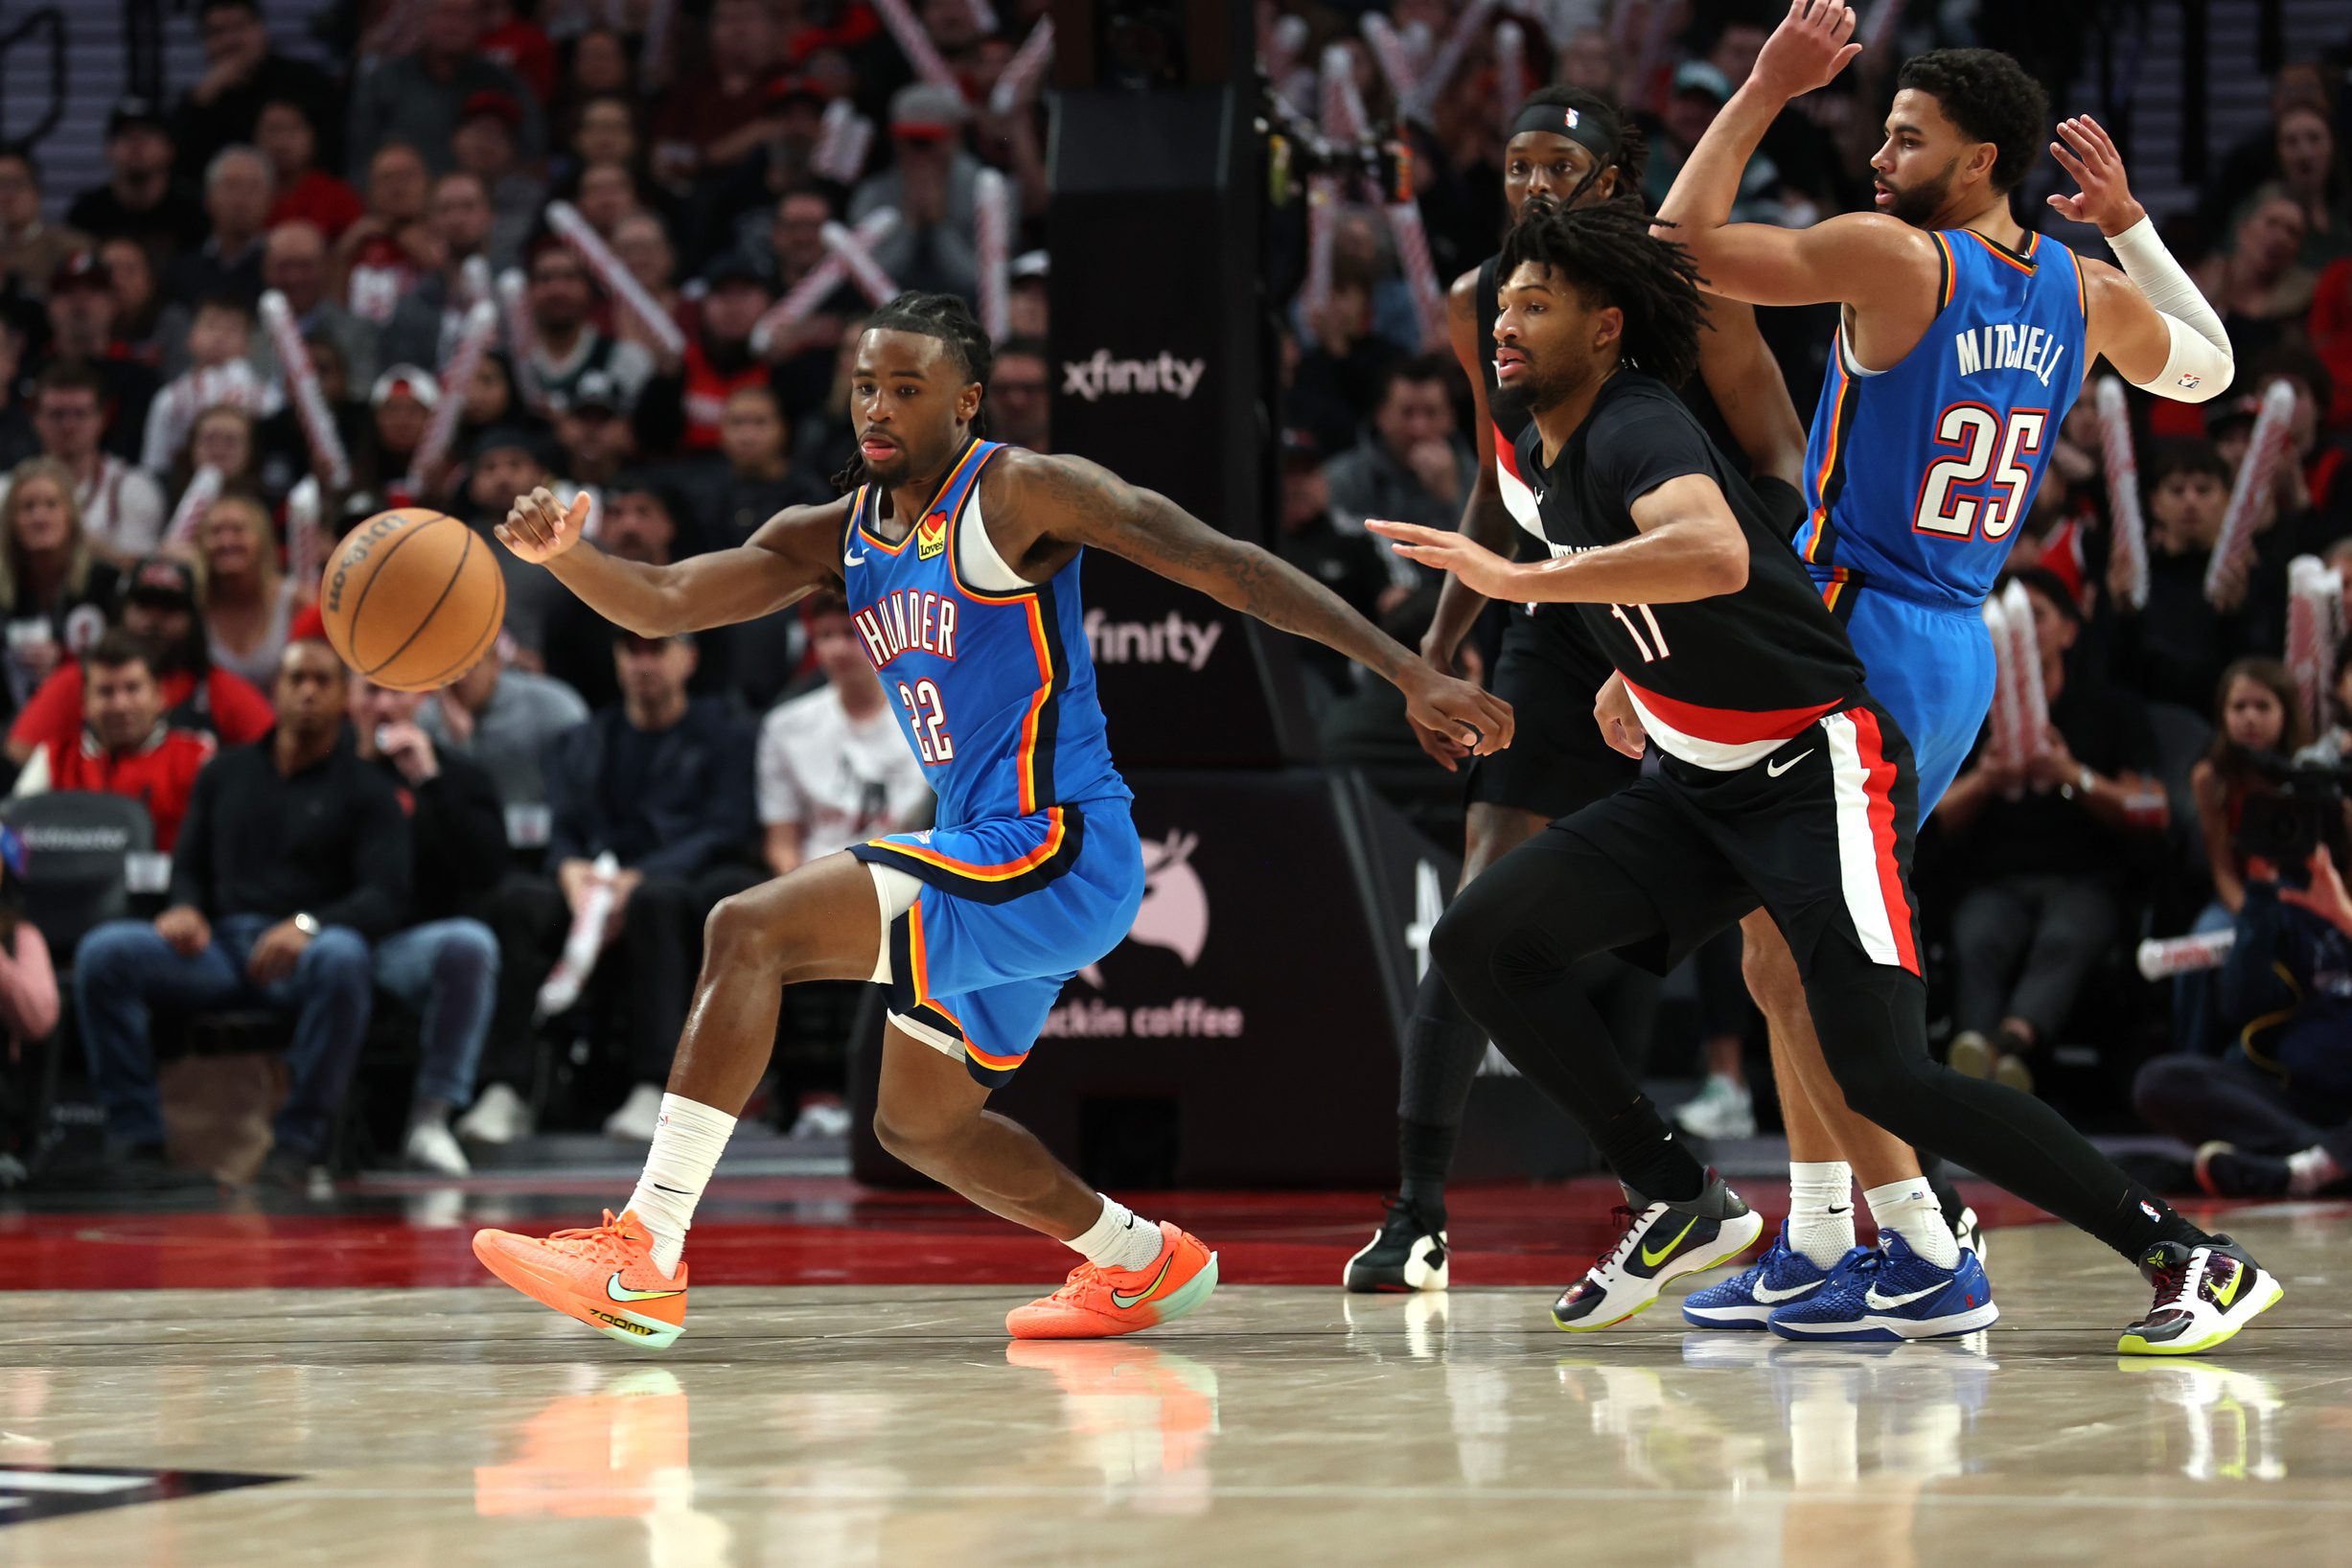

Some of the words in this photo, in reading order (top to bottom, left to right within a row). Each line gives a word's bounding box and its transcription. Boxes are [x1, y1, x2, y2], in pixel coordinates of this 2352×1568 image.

[1061, 348, 1206, 402] xfinity
[1956, 324, 2064, 387] MITCHELL
[1912, 401, 2049, 543] 25
[851, 588, 957, 671] HUNDER
[1083, 608, 1223, 671] finity
[898, 677, 954, 765] 22
[1039, 998, 1126, 1038] uckin
[1131, 997, 1244, 1038] coffee
